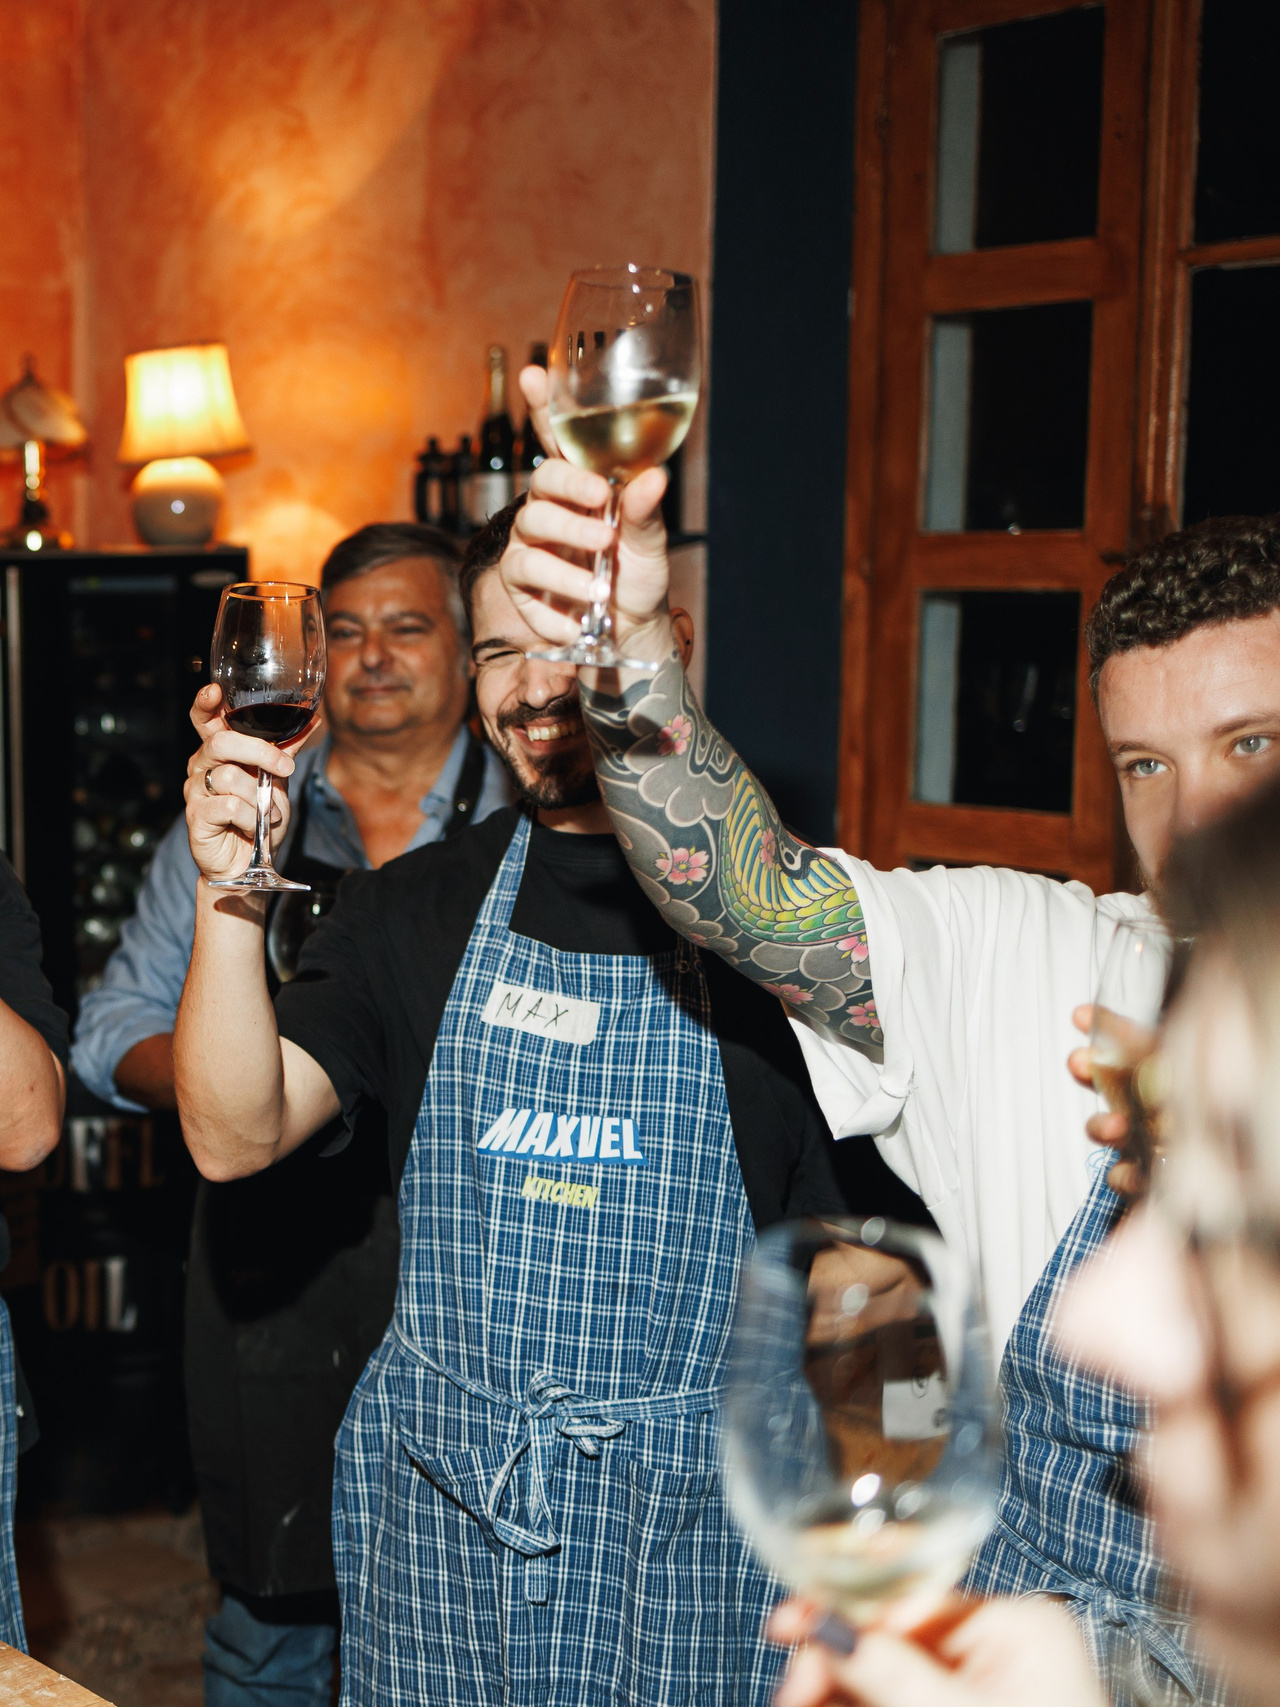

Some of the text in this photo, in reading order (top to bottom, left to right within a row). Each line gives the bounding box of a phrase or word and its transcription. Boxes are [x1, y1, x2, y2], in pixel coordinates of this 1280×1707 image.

[495, 992, 569, 1029] MAX
[476, 1107, 648, 1166] MAXVEL
[521, 1175, 598, 1208] KITCHEN
[42, 1256, 138, 1333] OIL
